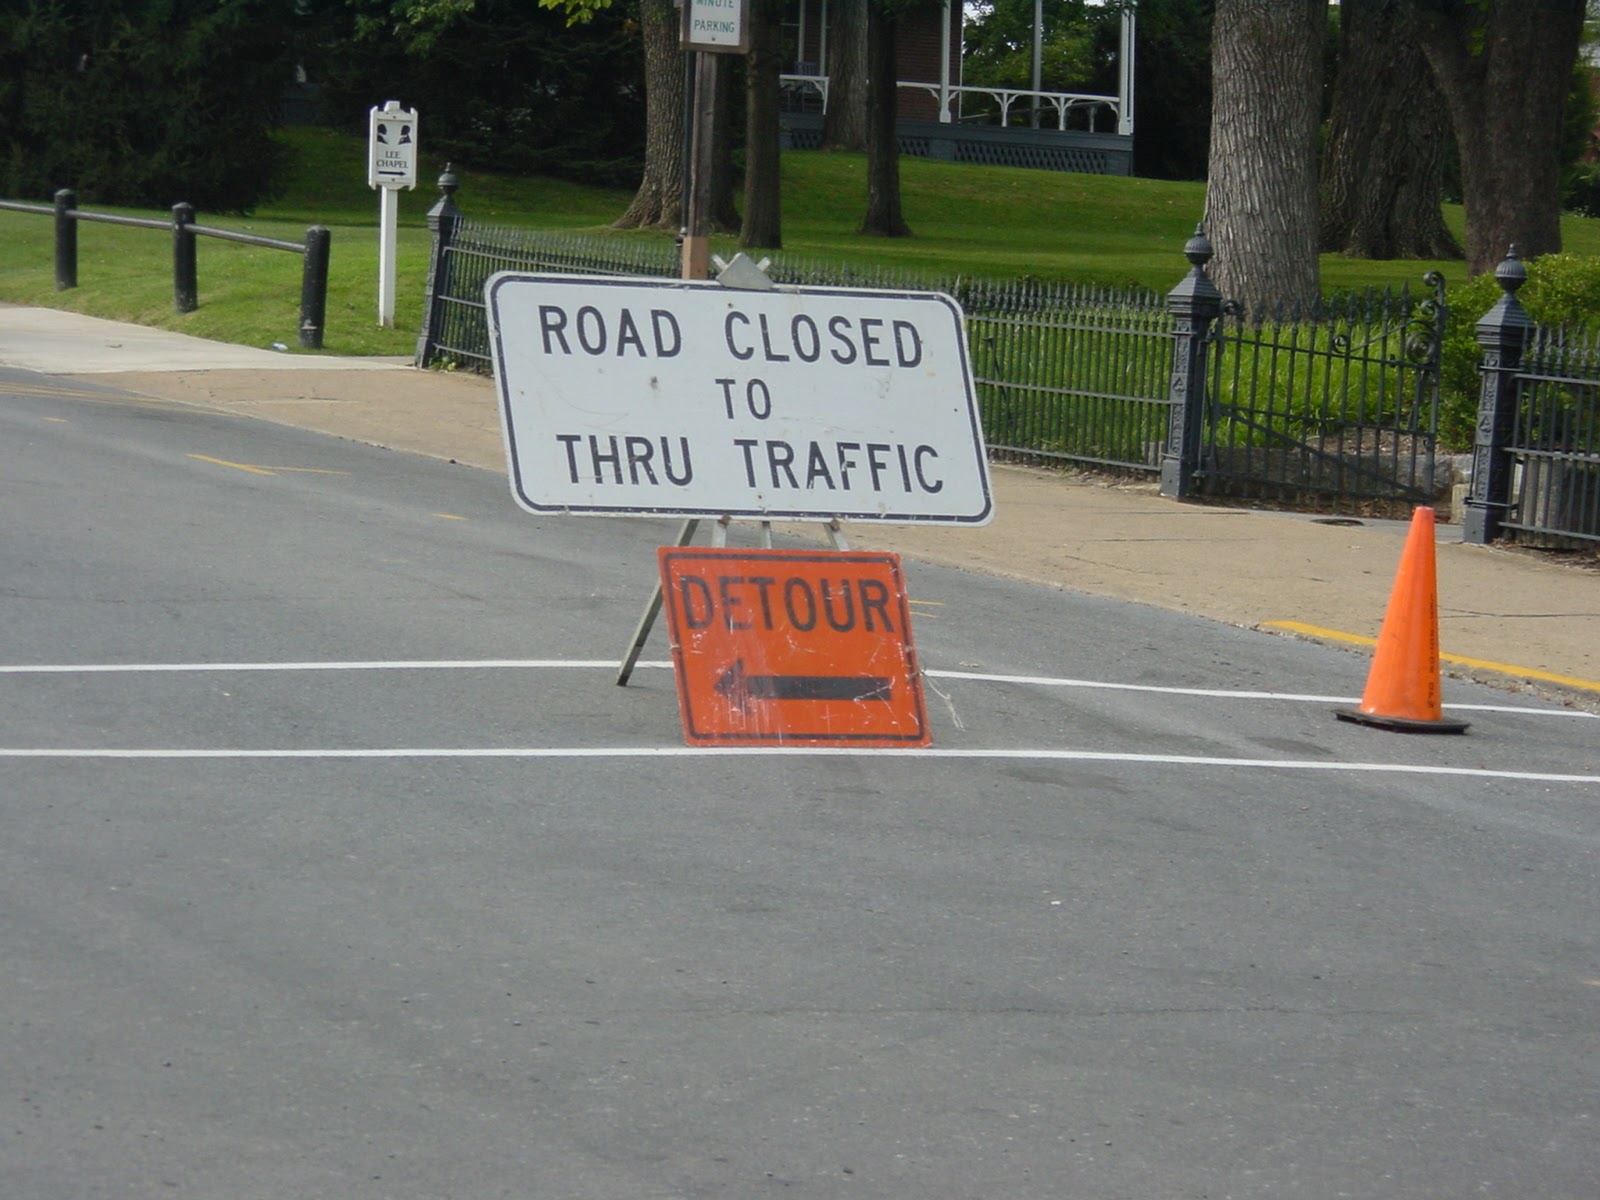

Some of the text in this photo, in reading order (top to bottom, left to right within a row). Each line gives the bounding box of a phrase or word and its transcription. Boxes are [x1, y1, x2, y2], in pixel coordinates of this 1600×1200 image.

[694, 19, 735, 32] PARKING
[376, 159, 408, 168] CHAPEL
[385, 151, 400, 159] LEE
[539, 305, 923, 369] ROAD CLOSED
[714, 378, 772, 420] TO
[556, 434, 944, 495] THRU TRAFFIC
[680, 575, 894, 633] DETOUR
